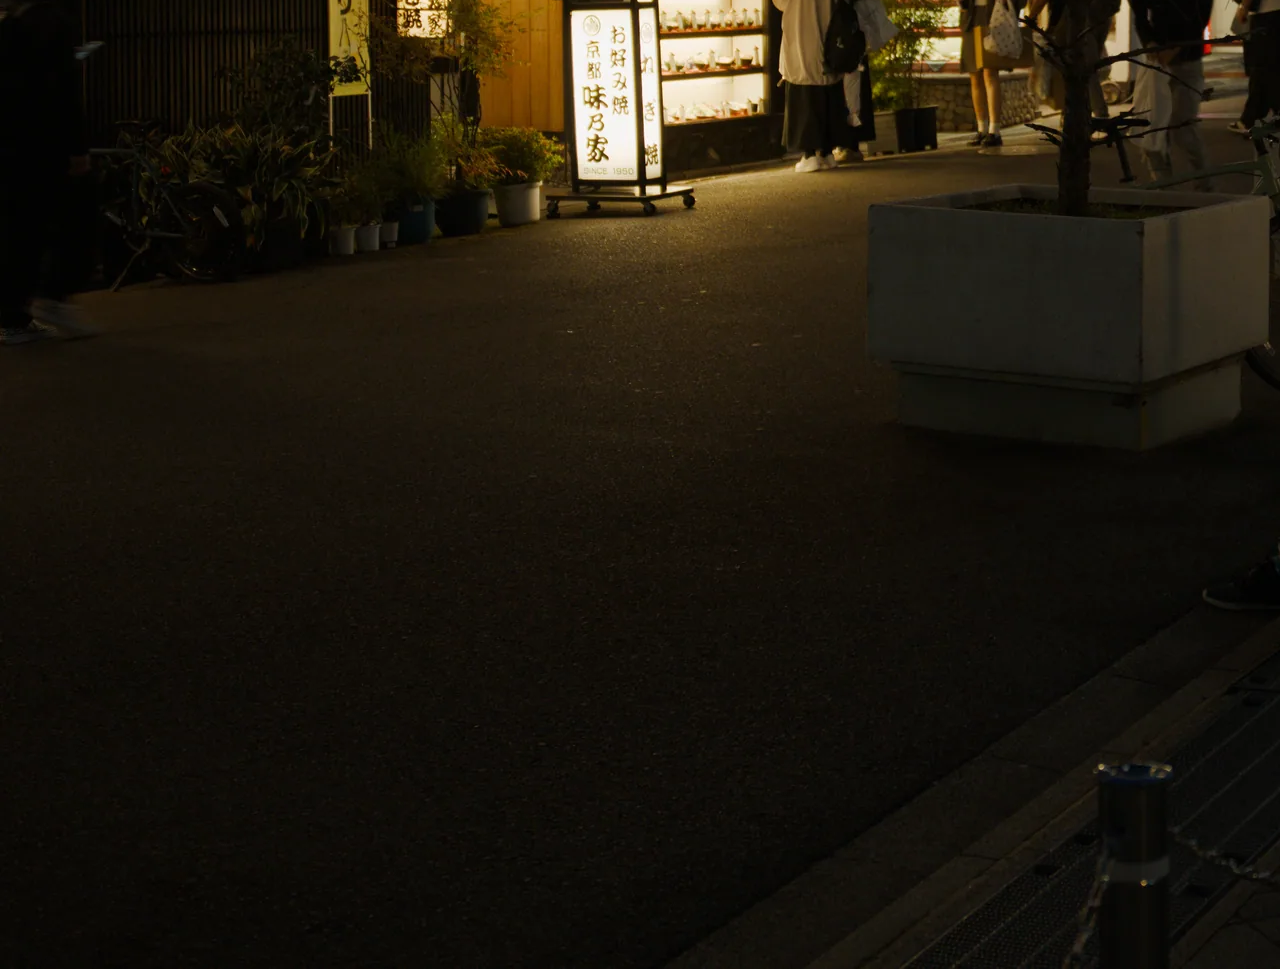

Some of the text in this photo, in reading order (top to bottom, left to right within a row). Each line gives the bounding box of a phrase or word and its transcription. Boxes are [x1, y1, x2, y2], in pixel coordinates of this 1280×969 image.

[610, 25, 630, 116] お好み焼
[583, 167, 635, 175] SINCE 1950
